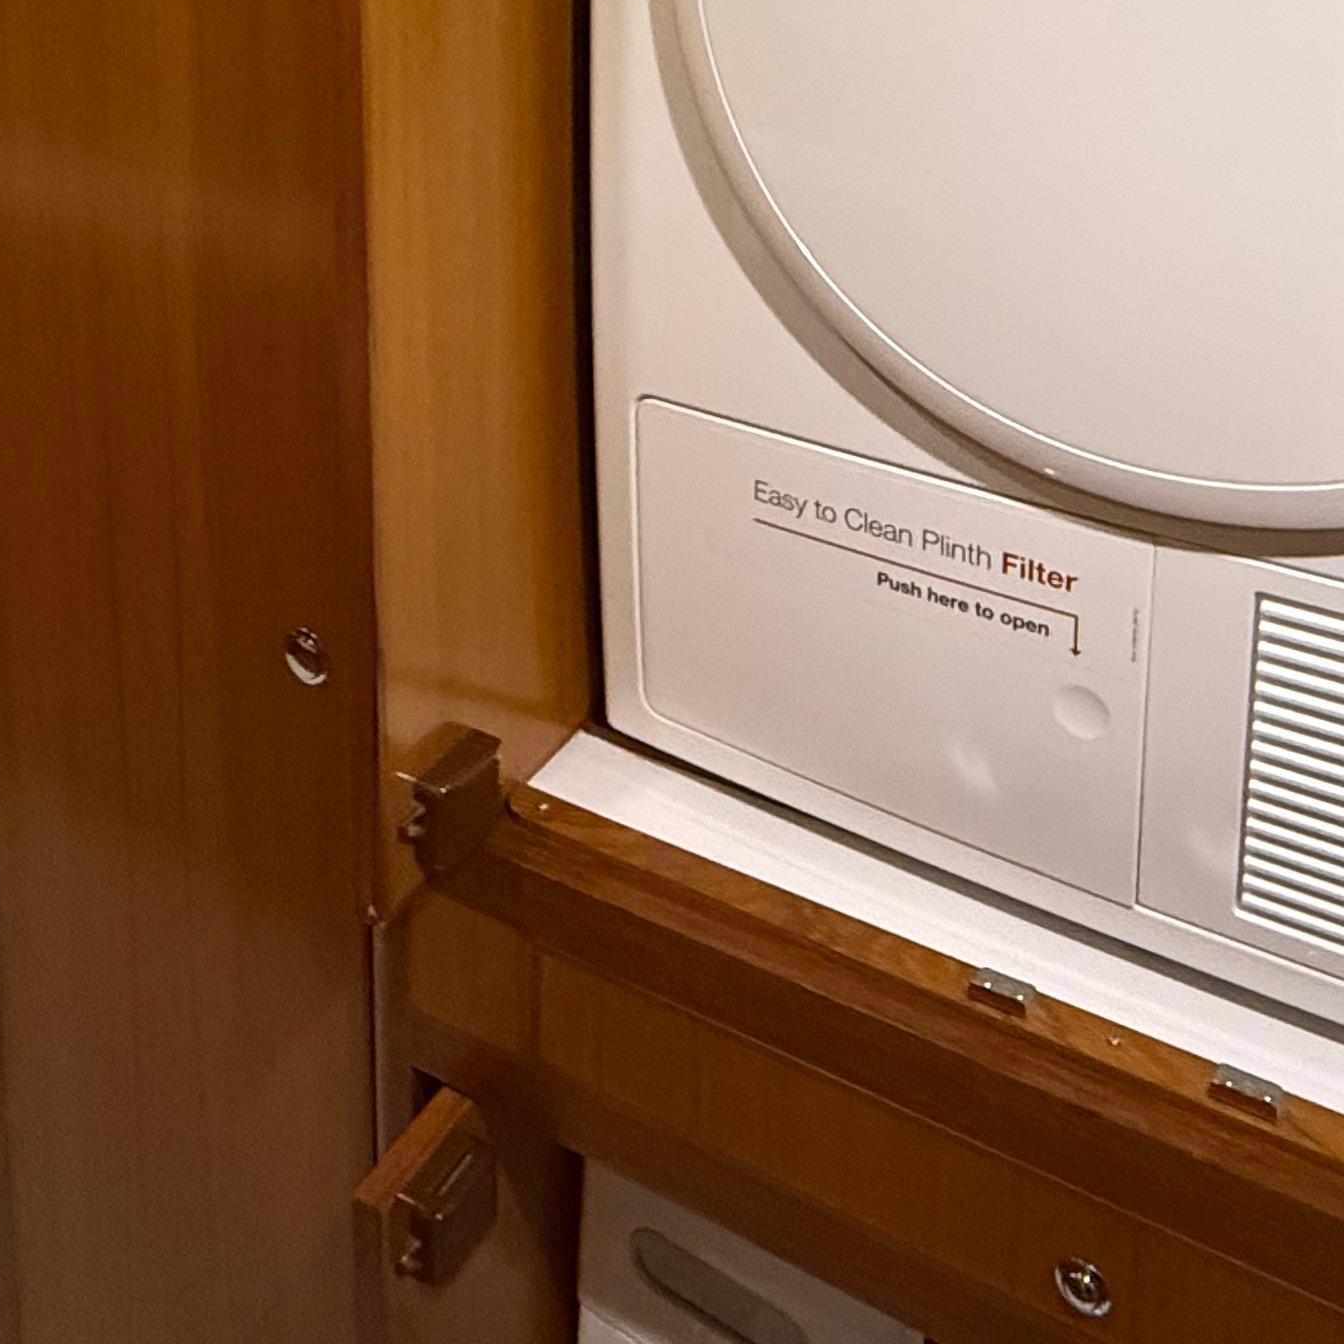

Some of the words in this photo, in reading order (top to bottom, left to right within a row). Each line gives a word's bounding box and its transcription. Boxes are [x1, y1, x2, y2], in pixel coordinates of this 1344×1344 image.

[753, 479, 808, 519] Easy
[814, 499, 837, 524] to
[844, 507, 913, 547] Clean
[922, 528, 992, 571] Plinth
[1002, 551, 1080, 593] Filter
[876, 570, 923, 599] Push
[927, 586, 970, 613] here
[976, 601, 995, 621] to
[1000, 612, 1051, 638] open
